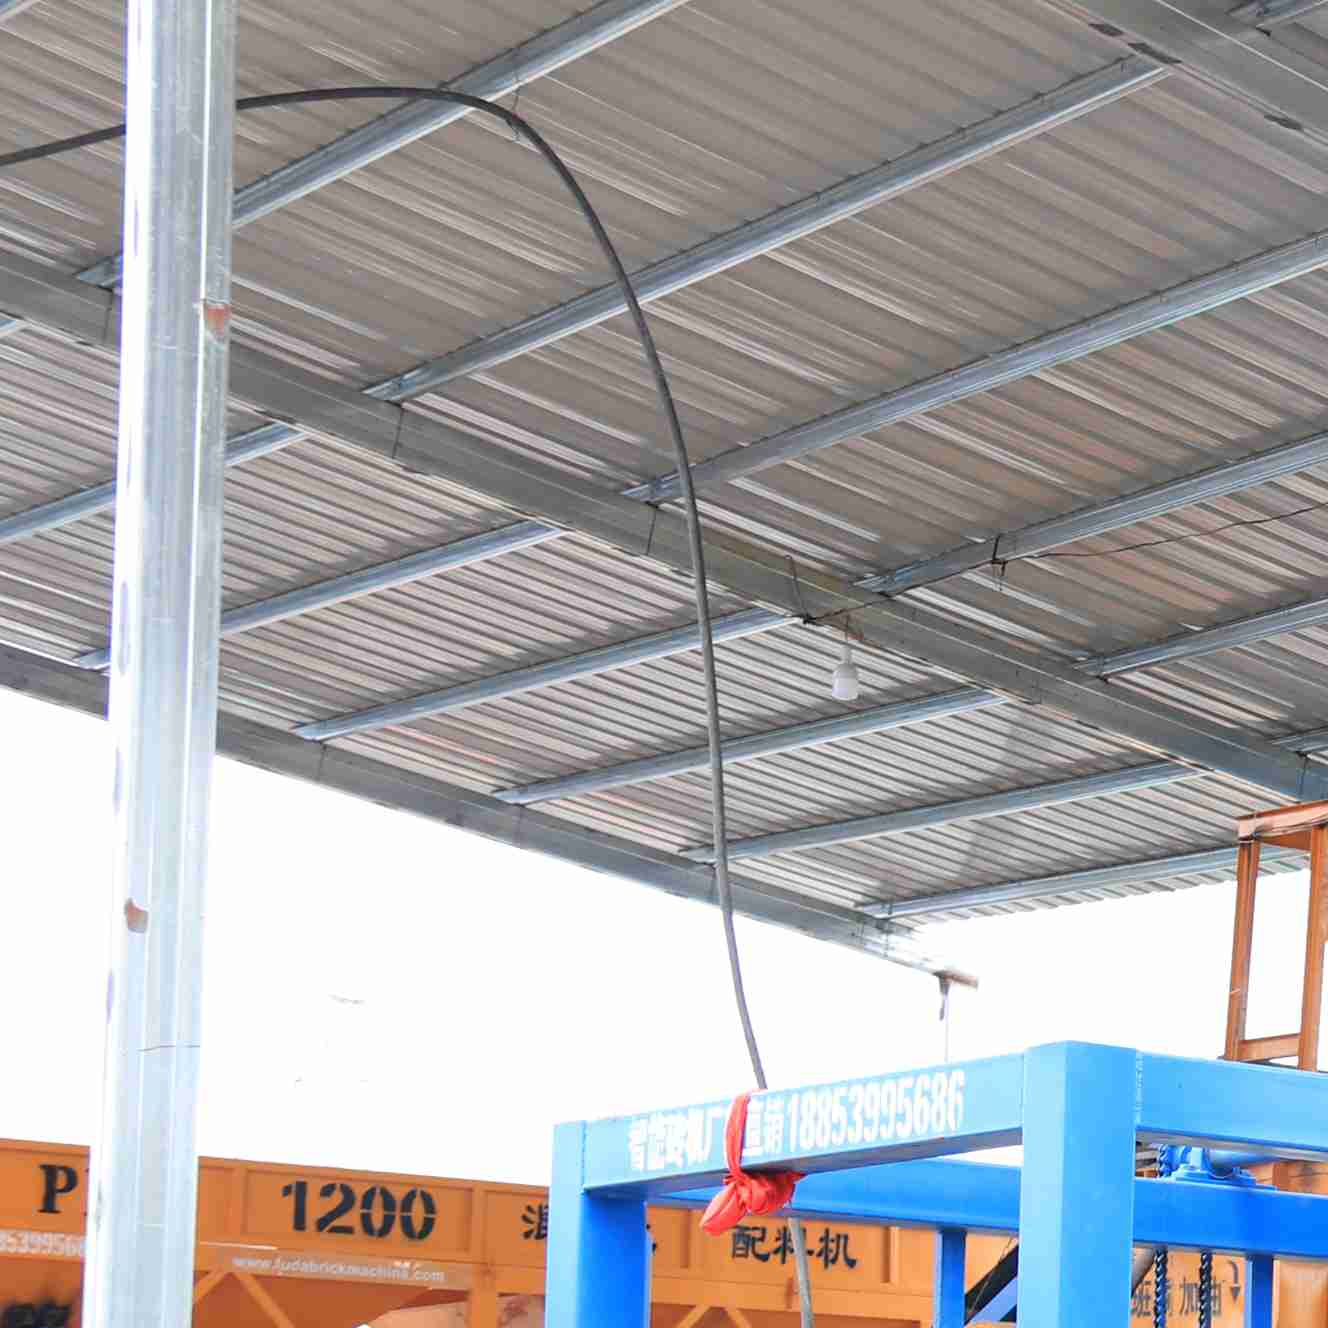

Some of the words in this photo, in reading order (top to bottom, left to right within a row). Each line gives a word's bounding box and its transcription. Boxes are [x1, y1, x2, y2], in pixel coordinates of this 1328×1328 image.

[281, 1180, 438, 1241] 1200
[731, 1225, 858, 1271] 配料机
